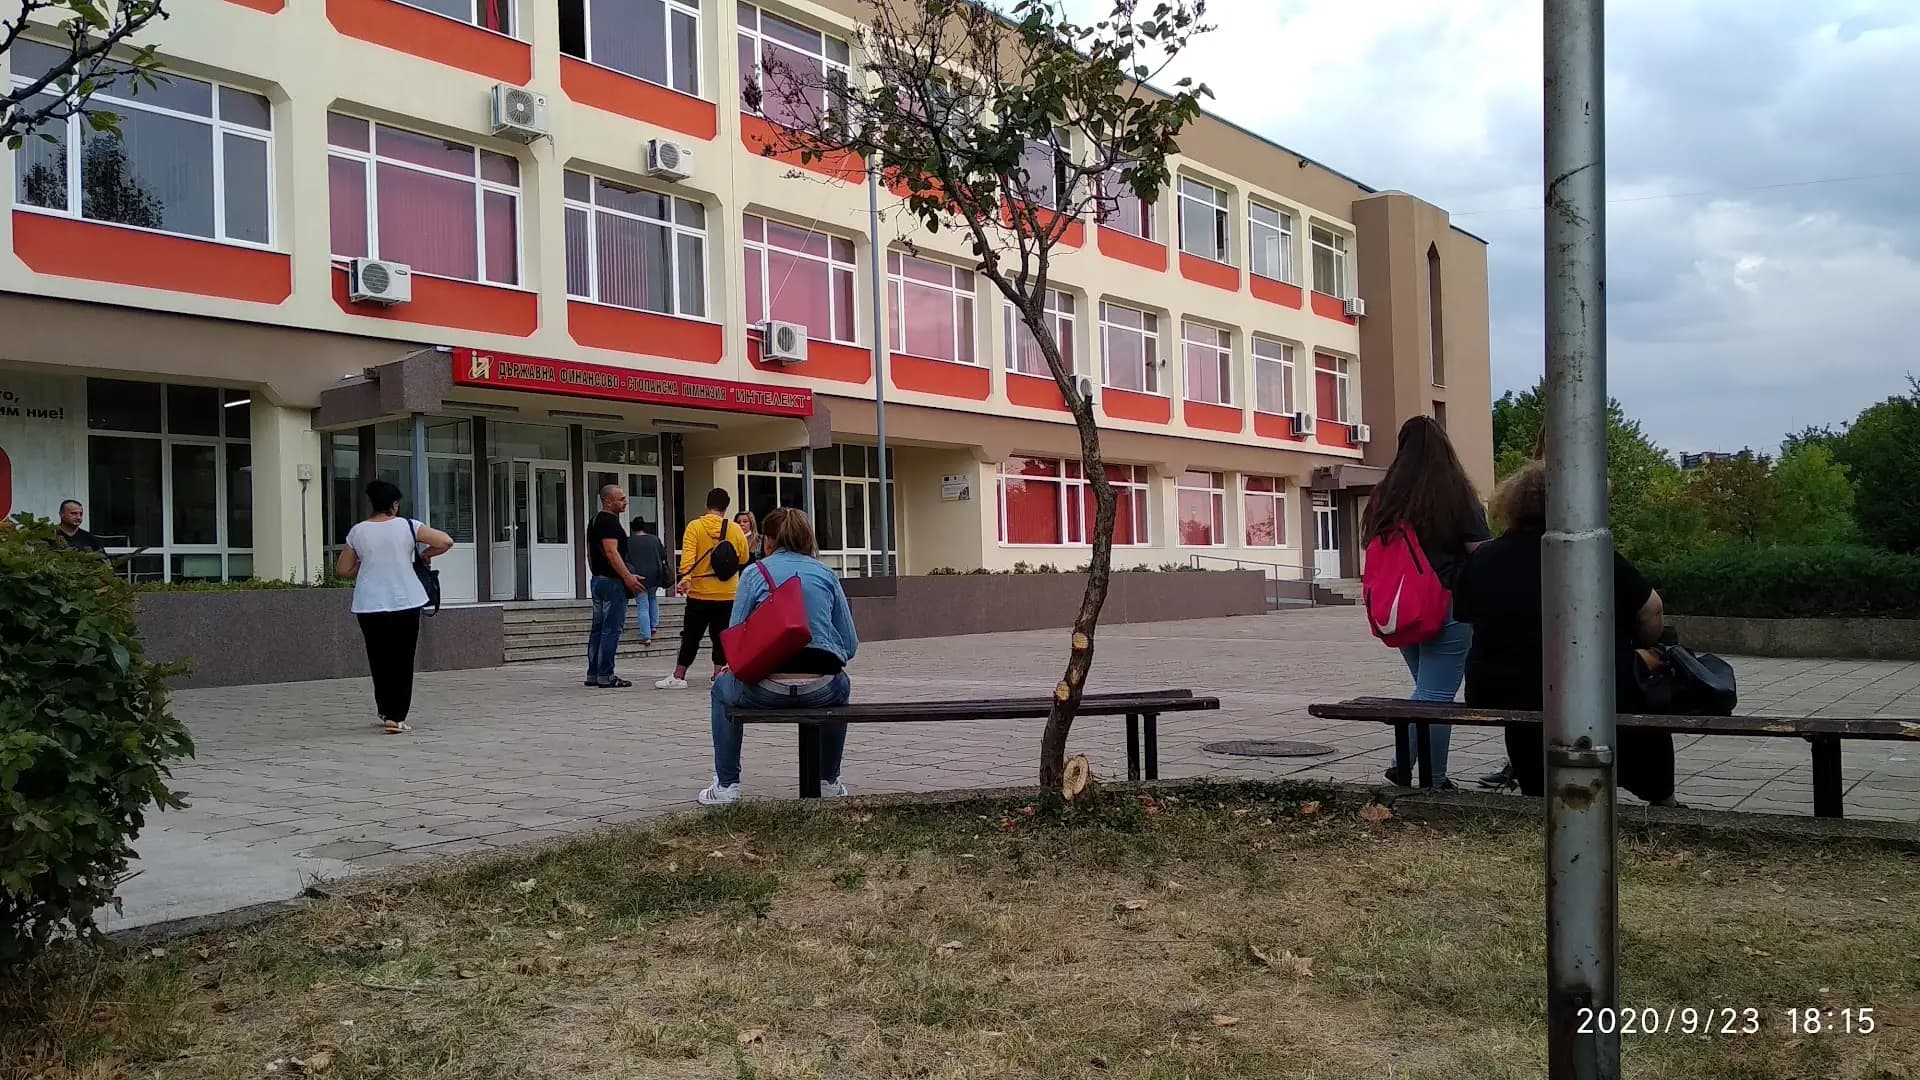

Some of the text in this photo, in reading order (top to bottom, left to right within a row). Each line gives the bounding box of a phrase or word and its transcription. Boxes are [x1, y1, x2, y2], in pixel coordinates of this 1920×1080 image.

[498, 361, 555, 382] ДЪРЖАВНА
[682, 382, 727, 401] ГИМНАЗИЯ
[26, 407, 64, 419] ние!
